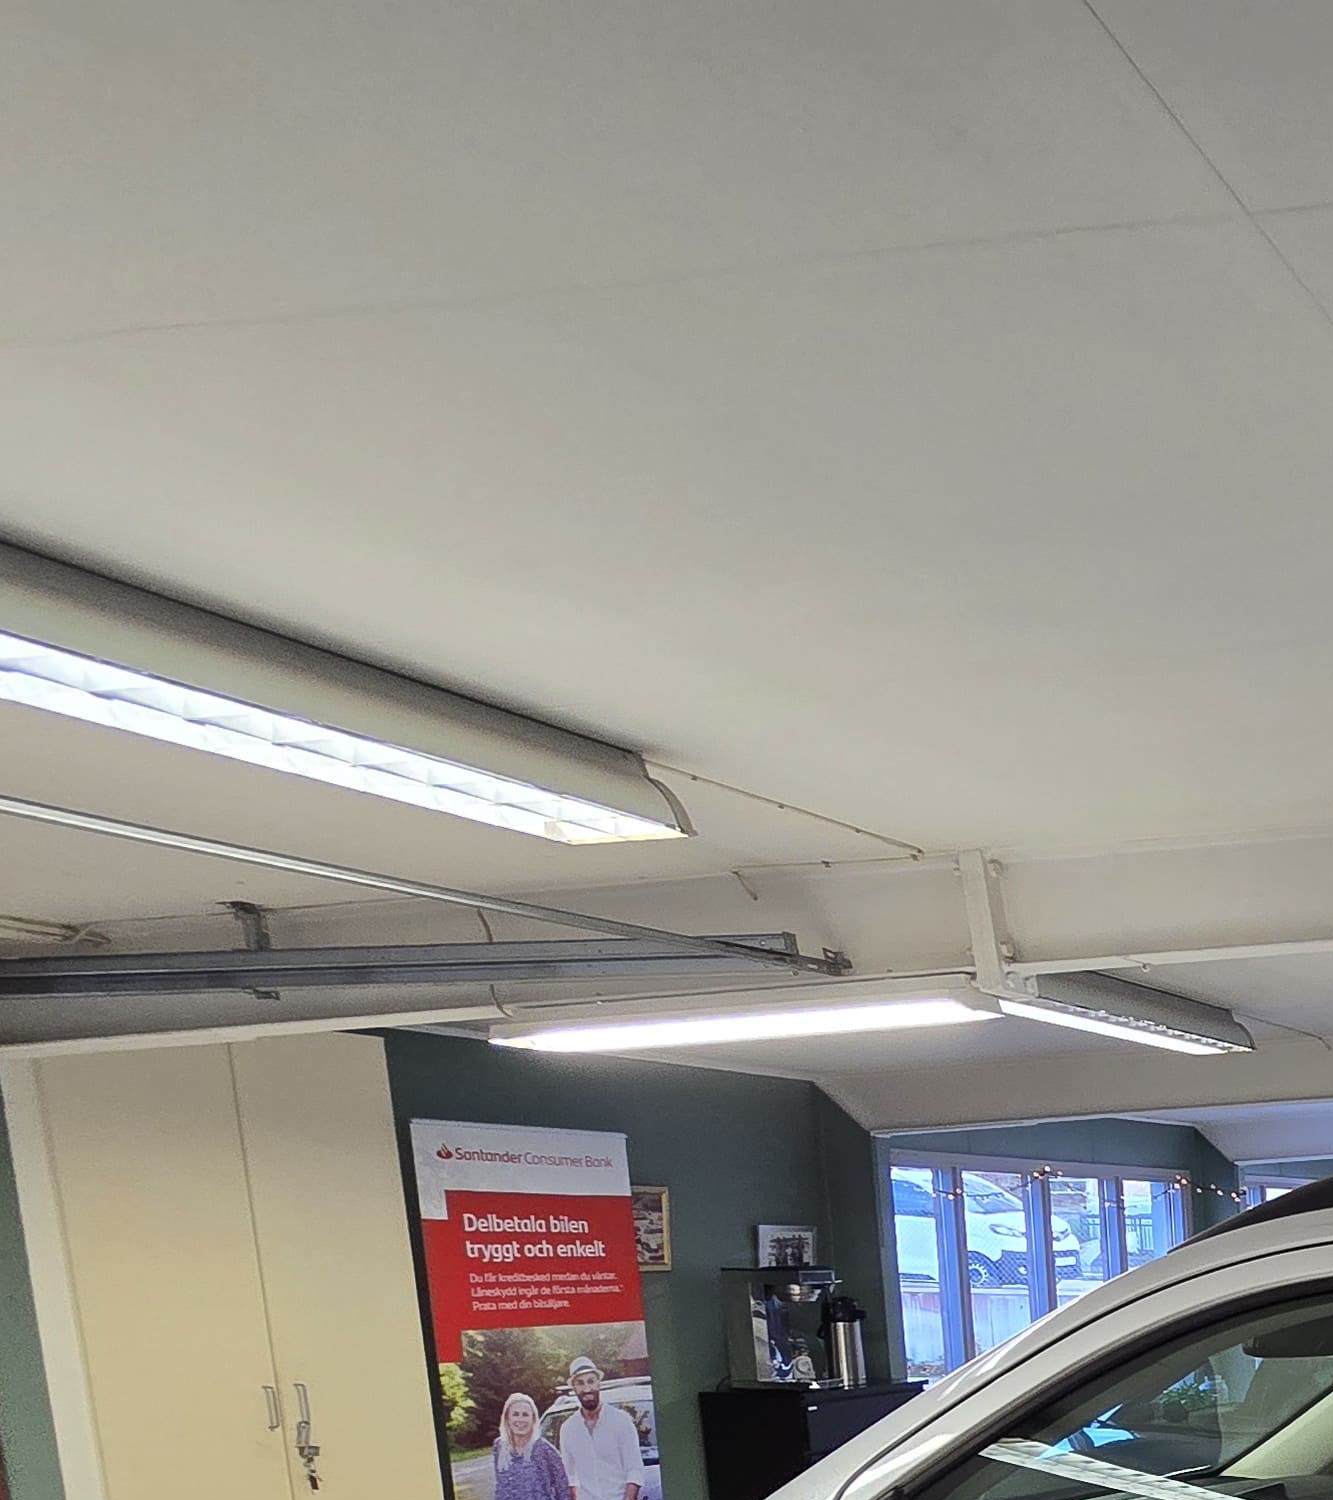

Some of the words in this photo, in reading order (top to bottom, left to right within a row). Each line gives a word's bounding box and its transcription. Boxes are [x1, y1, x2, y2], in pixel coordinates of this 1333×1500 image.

[455, 1147, 521, 1164] Santander
[524, 1152, 585, 1167] Consumer
[585, 1155, 613, 1168] Bank
[463, 1213, 546, 1232] Delbetala
[549, 1215, 589, 1233] bilen
[466, 1240, 521, 1262] tryggt
[524, 1240, 553, 1257] och
[556, 1240, 606, 1257] enkelt
[469, 1272, 483, 1283] Du
